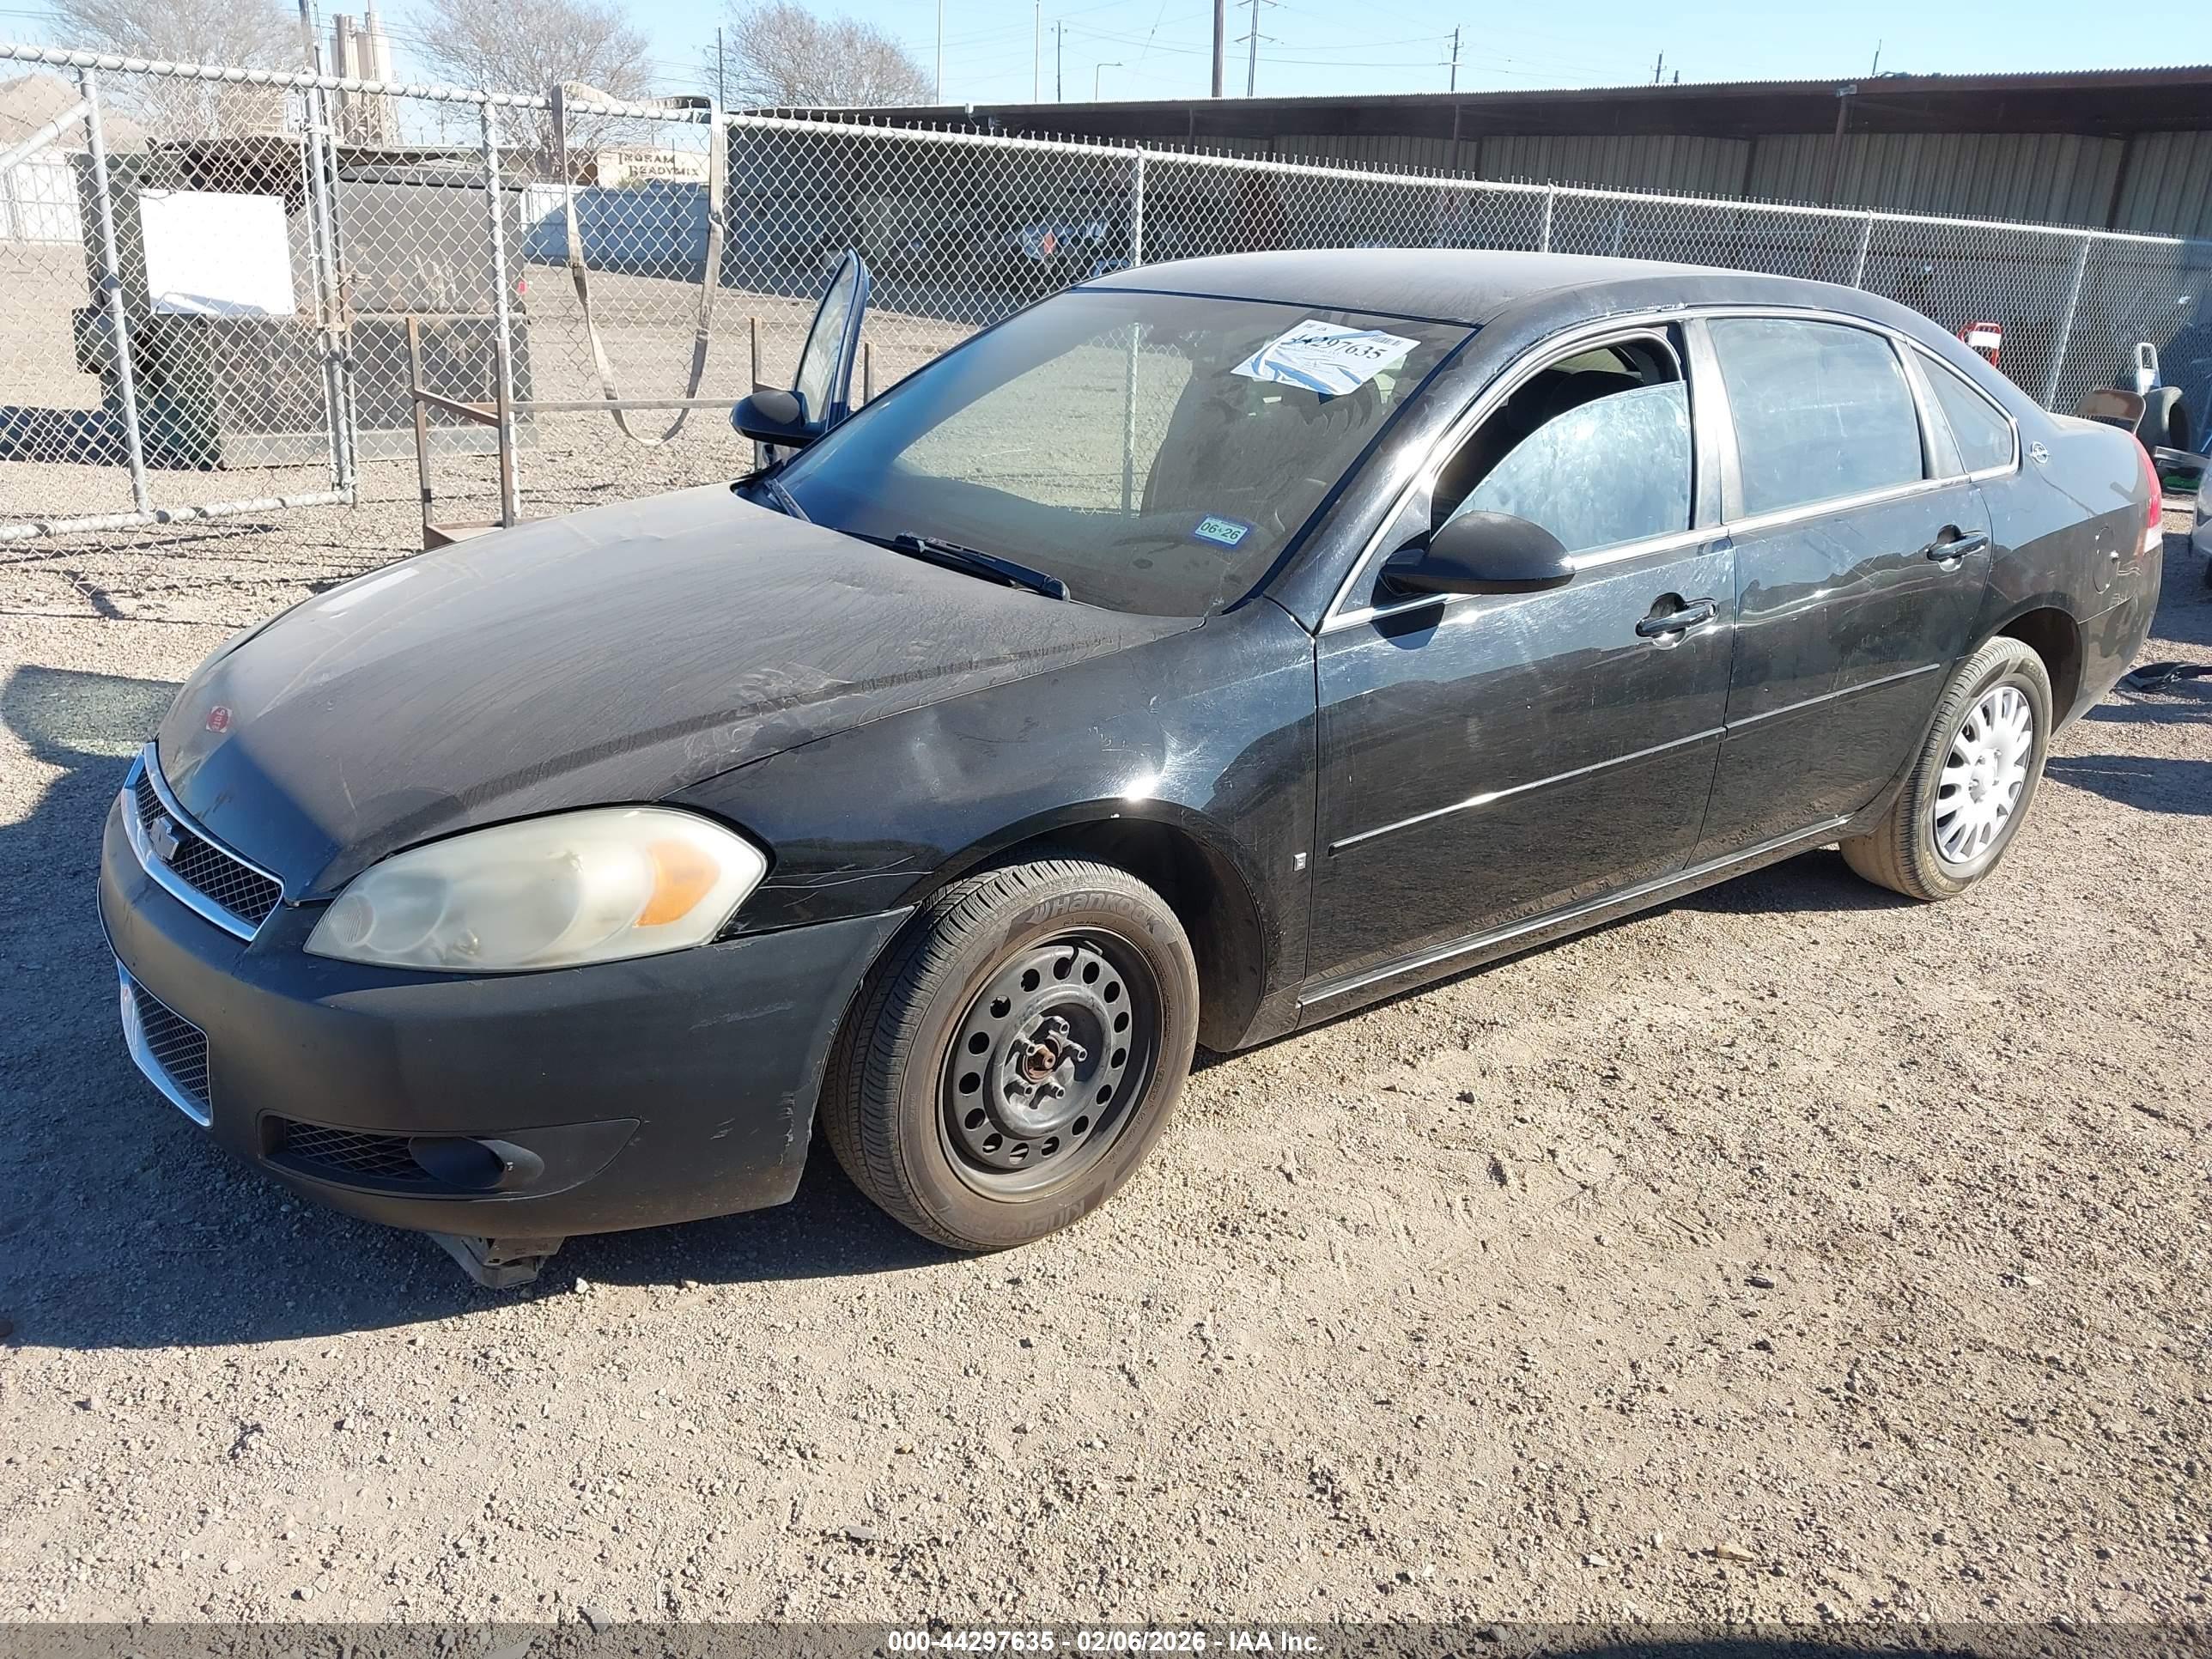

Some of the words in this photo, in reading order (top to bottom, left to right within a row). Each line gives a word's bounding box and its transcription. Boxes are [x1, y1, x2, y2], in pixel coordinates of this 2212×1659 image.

[618, 153, 674, 165] INGRAM
[1200, 522, 1219, 533] 06
[1220, 528, 1241, 540] 26
